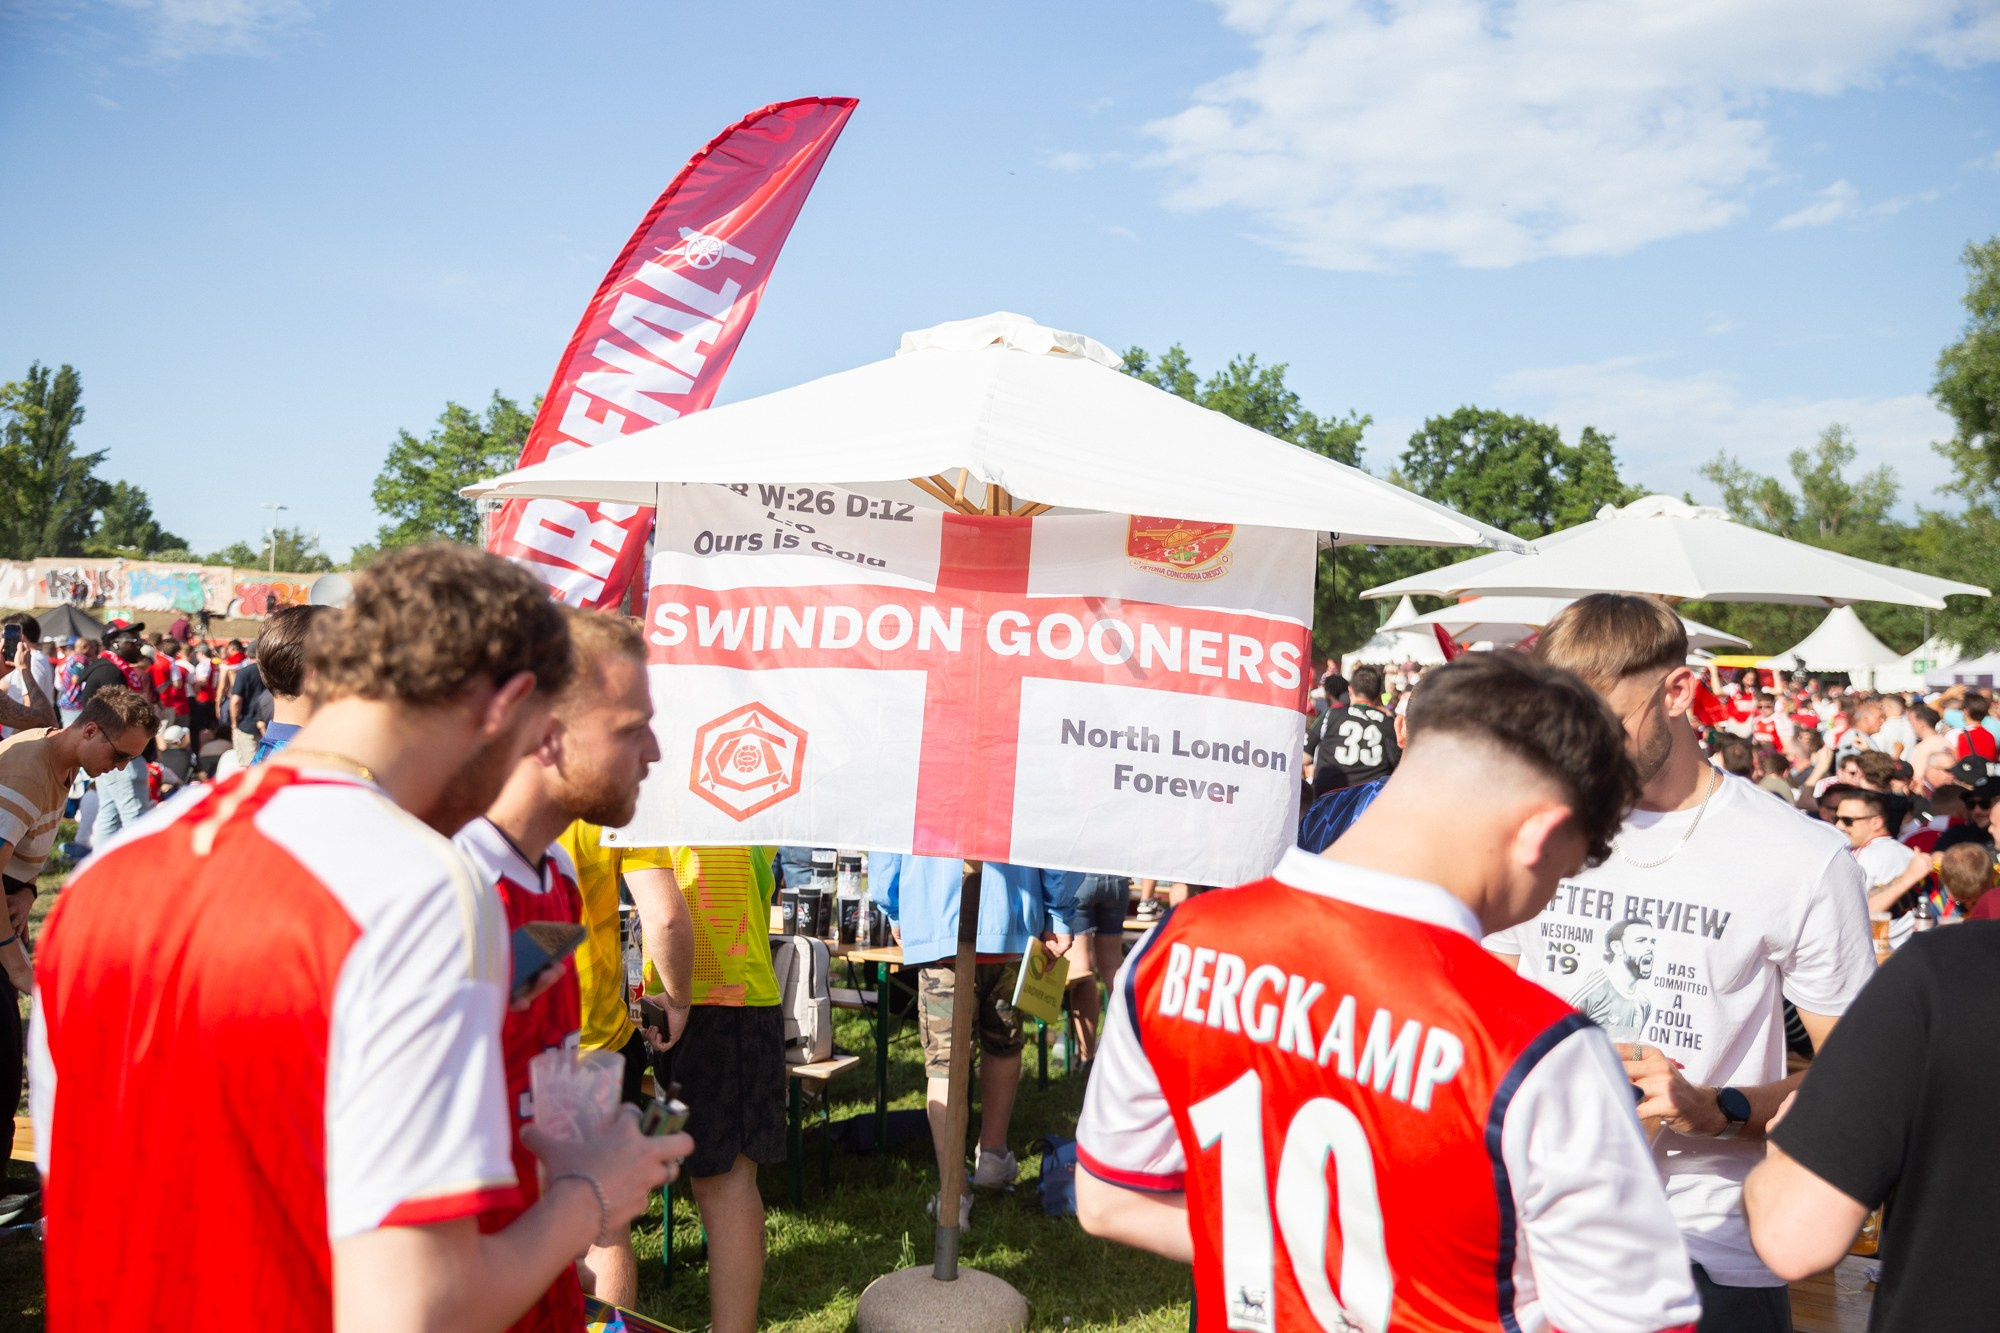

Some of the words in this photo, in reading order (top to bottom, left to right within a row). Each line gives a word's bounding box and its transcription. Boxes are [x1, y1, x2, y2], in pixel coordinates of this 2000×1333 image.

[505, 260, 742, 610] ARENAL
[758, 484, 835, 515] W:26
[847, 494, 914, 522] D:12
[694, 530, 763, 555] Ours
[773, 528, 800, 549] is
[1166, 569, 1202, 580] CONCORDIA
[1202, 566, 1224, 579] CRESCIT
[649, 602, 965, 652] SWINDON
[986, 610, 1302, 690] GOONERS
[1060, 718, 1160, 754] North
[1172, 730, 1287, 772] London
[1334, 720, 1382, 767] 33
[1113, 764, 1240, 805] Forever
[1543, 884, 1614, 921] FTER
[1623, 895, 1731, 941] REVIEW
[1540, 922, 1594, 944] WESTHAM
[1548, 941, 1581, 956] NO.
[1546, 954, 1579, 975] 19
[1667, 963, 1696, 979] HAS
[1654, 976, 1708, 996] COMMITTED
[1672, 994, 1682, 1010] A
[1158, 942, 1465, 1112] BERGKAMP
[1655, 1009, 1693, 1029] FOUL
[1648, 1026, 1671, 1044] ON
[1674, 1030, 1703, 1050] THE
[1187, 1068, 1394, 1333] 10
